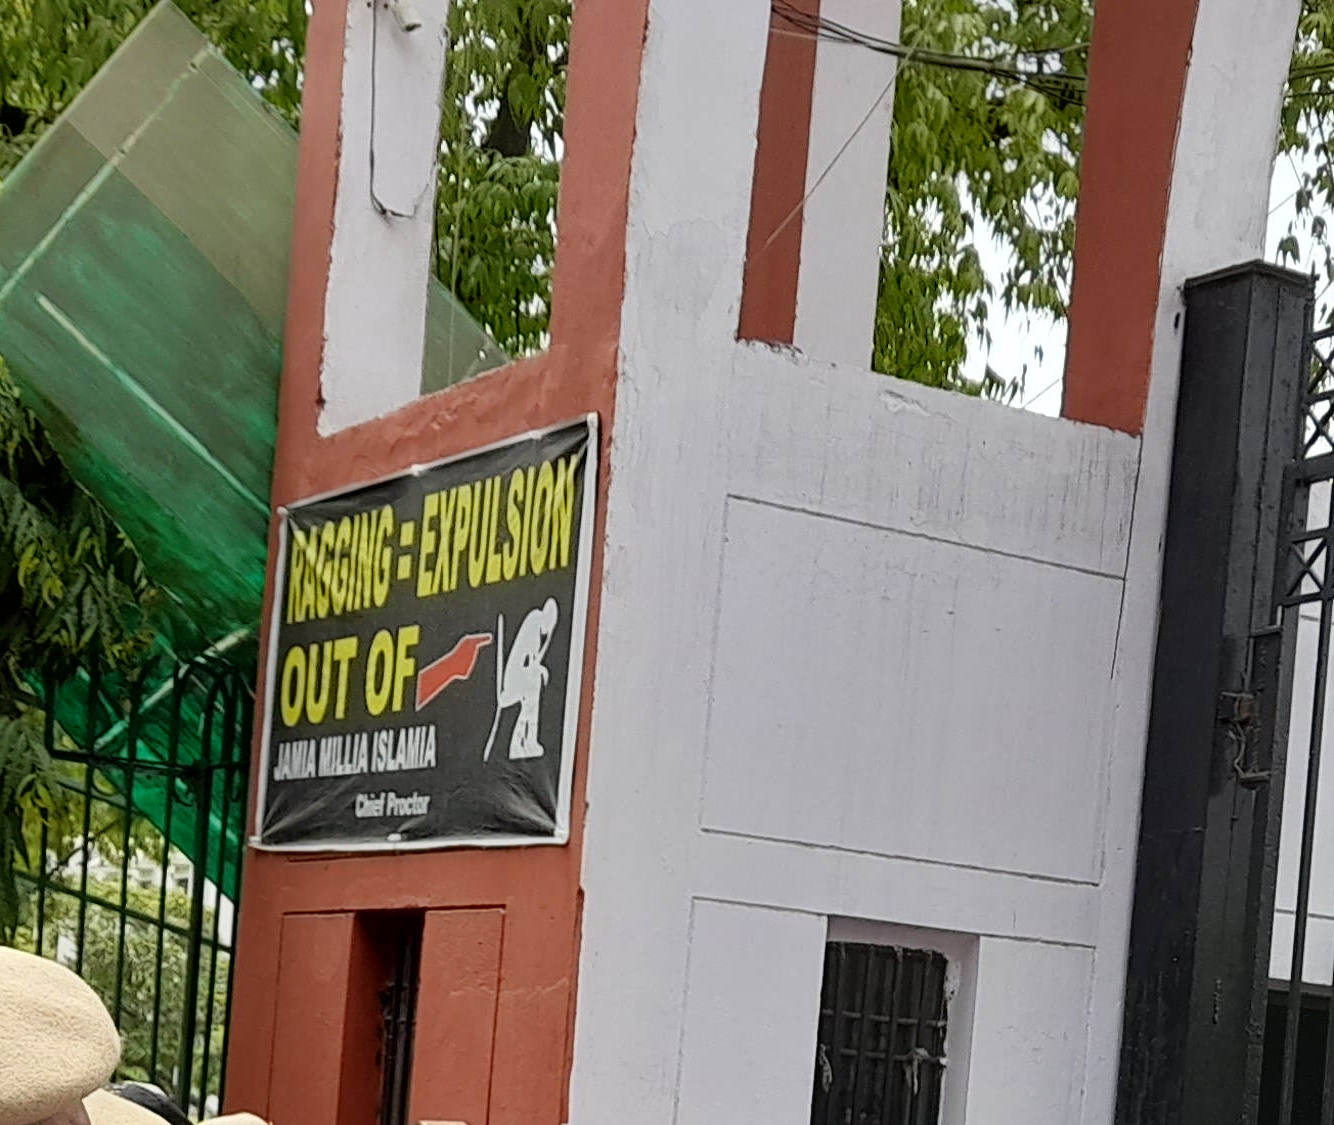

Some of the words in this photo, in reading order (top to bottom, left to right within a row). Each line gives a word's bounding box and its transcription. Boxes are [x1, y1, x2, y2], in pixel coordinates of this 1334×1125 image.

[286, 504, 394, 624] RAGGING
[417, 453, 580, 598] EXPULSION
[280, 635, 359, 727] OUT
[365, 624, 421, 716] OF
[273, 738, 317, 781] JAMIA
[318, 731, 368, 778] MILLIA
[370, 723, 437, 773] ISLAMIA
[355, 792, 386, 818] Chief
[386, 791, 431, 817] Proctor
